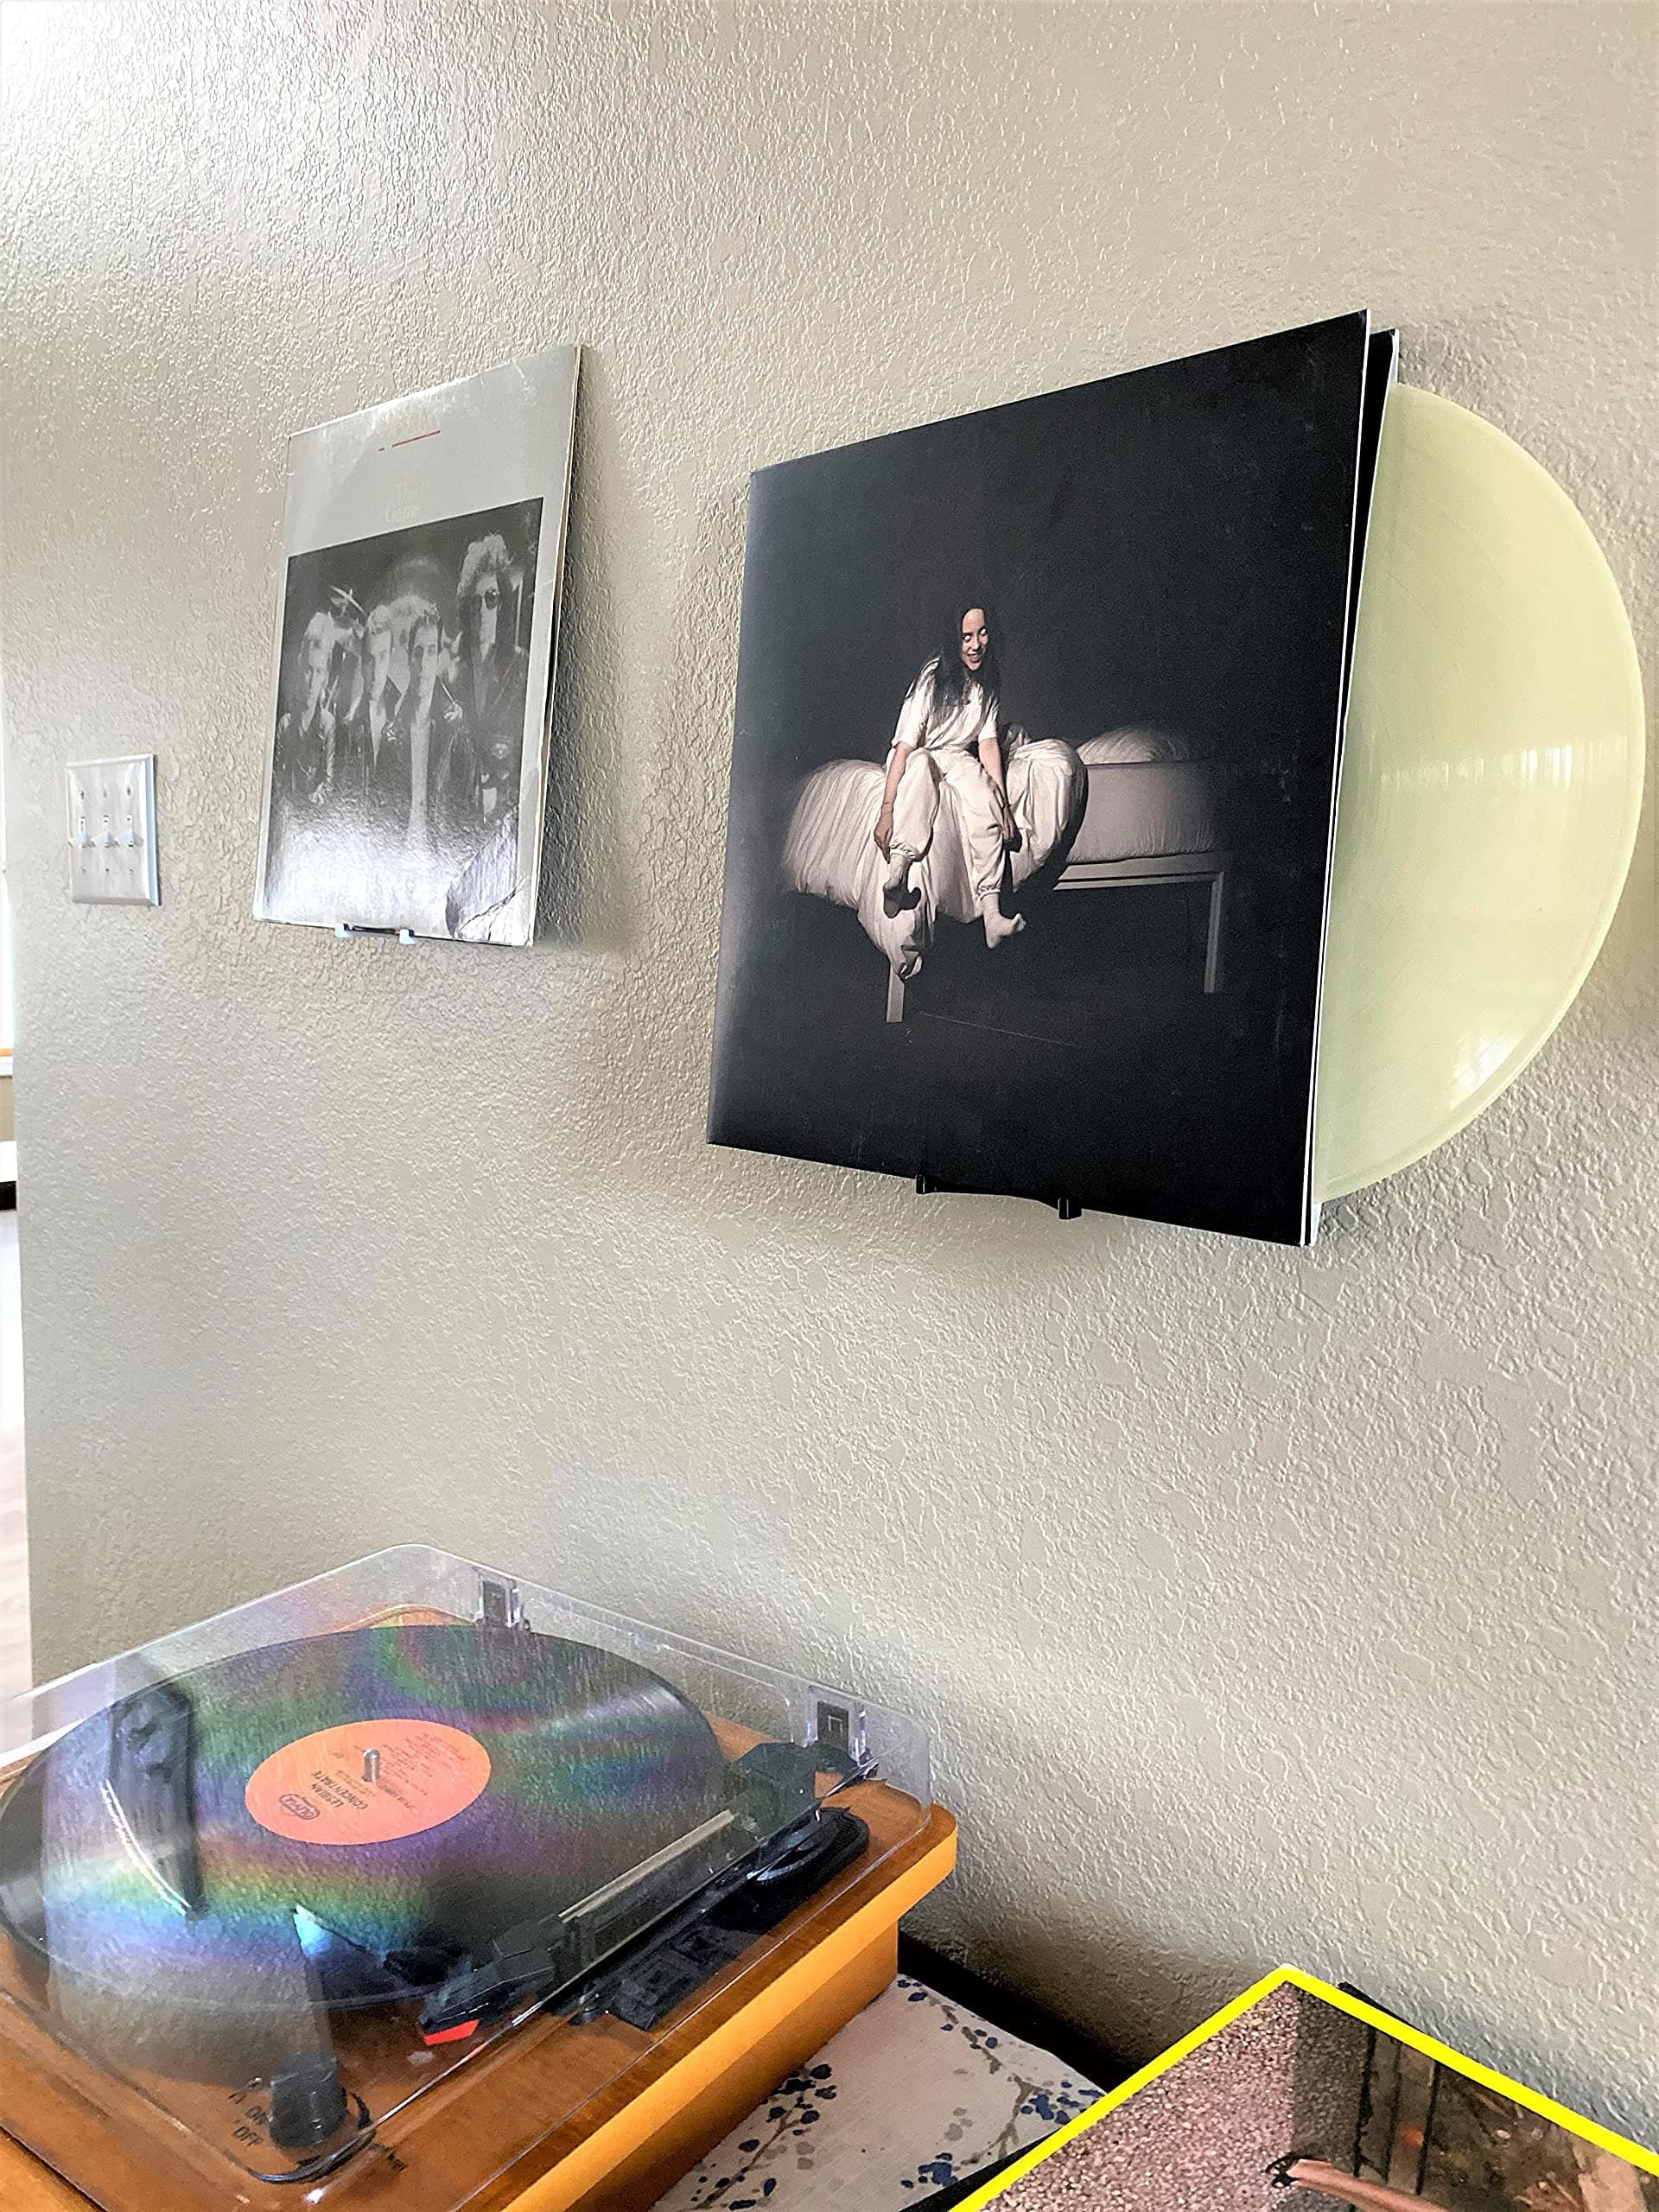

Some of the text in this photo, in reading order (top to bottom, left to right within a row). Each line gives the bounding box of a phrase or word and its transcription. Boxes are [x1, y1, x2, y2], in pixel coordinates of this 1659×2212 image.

[310, 1770, 369, 1810] CONCENTRATE
[311, 1783, 345, 1808] LESBIAN
[283, 1796, 316, 1818] OLIVIA
[232, 2126, 264, 2146] OFF
